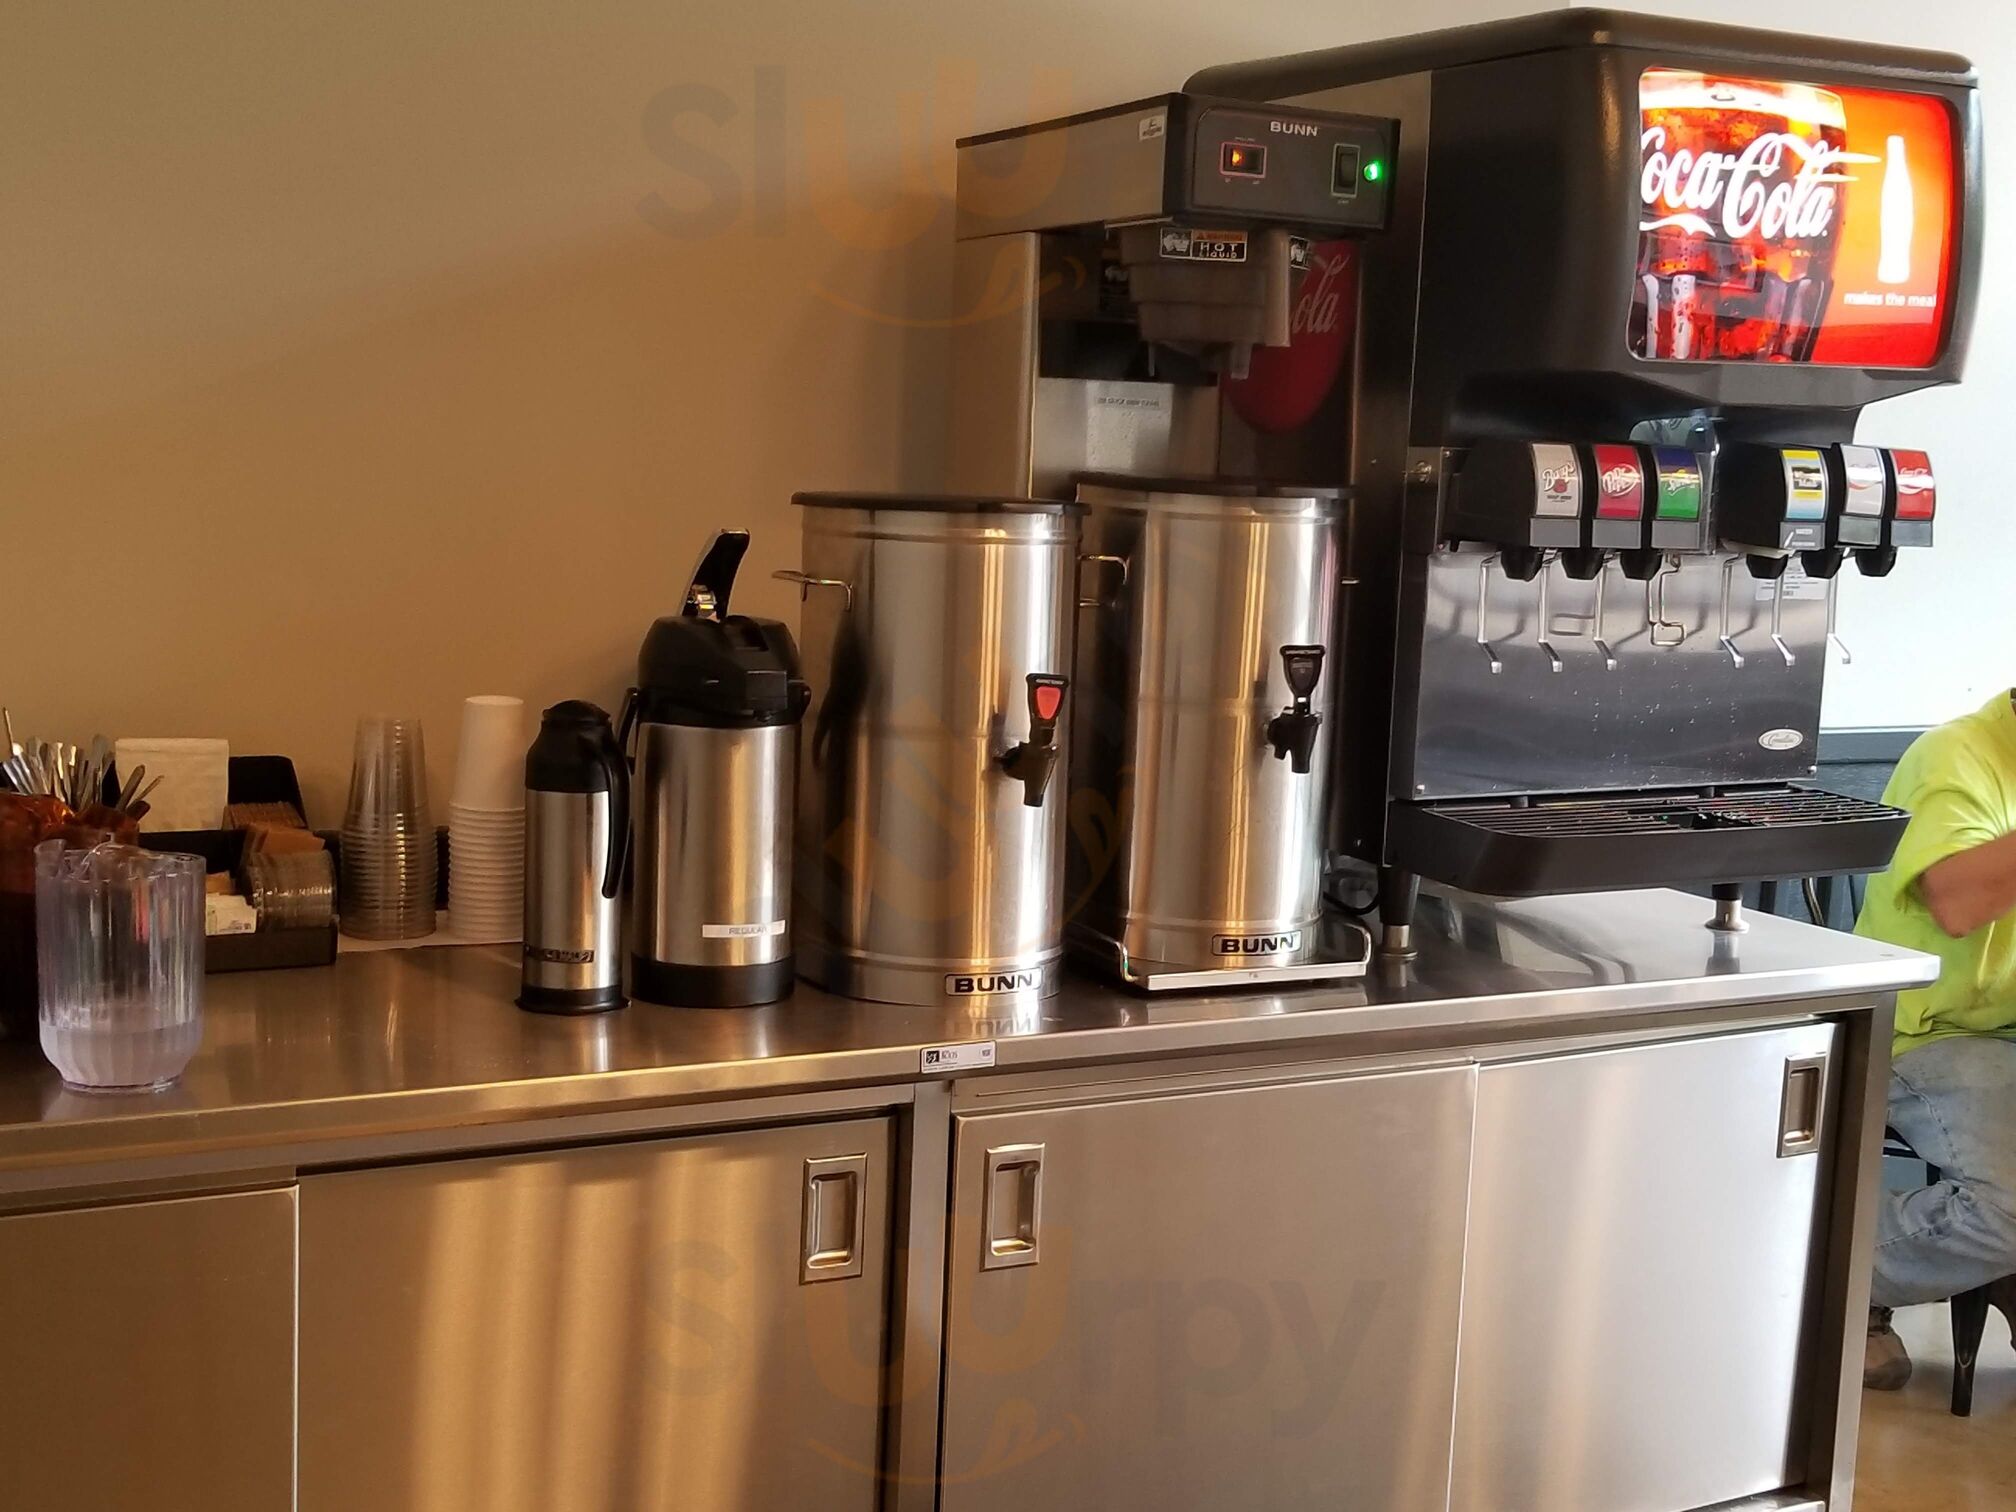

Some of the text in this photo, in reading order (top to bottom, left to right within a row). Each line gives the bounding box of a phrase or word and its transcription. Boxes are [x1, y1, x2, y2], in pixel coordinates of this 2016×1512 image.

[1270, 121, 1318, 137] BUNN
[1200, 242, 1238, 252] HOT
[1221, 935, 1294, 954] BUNN
[954, 973, 1034, 993] BUNN
